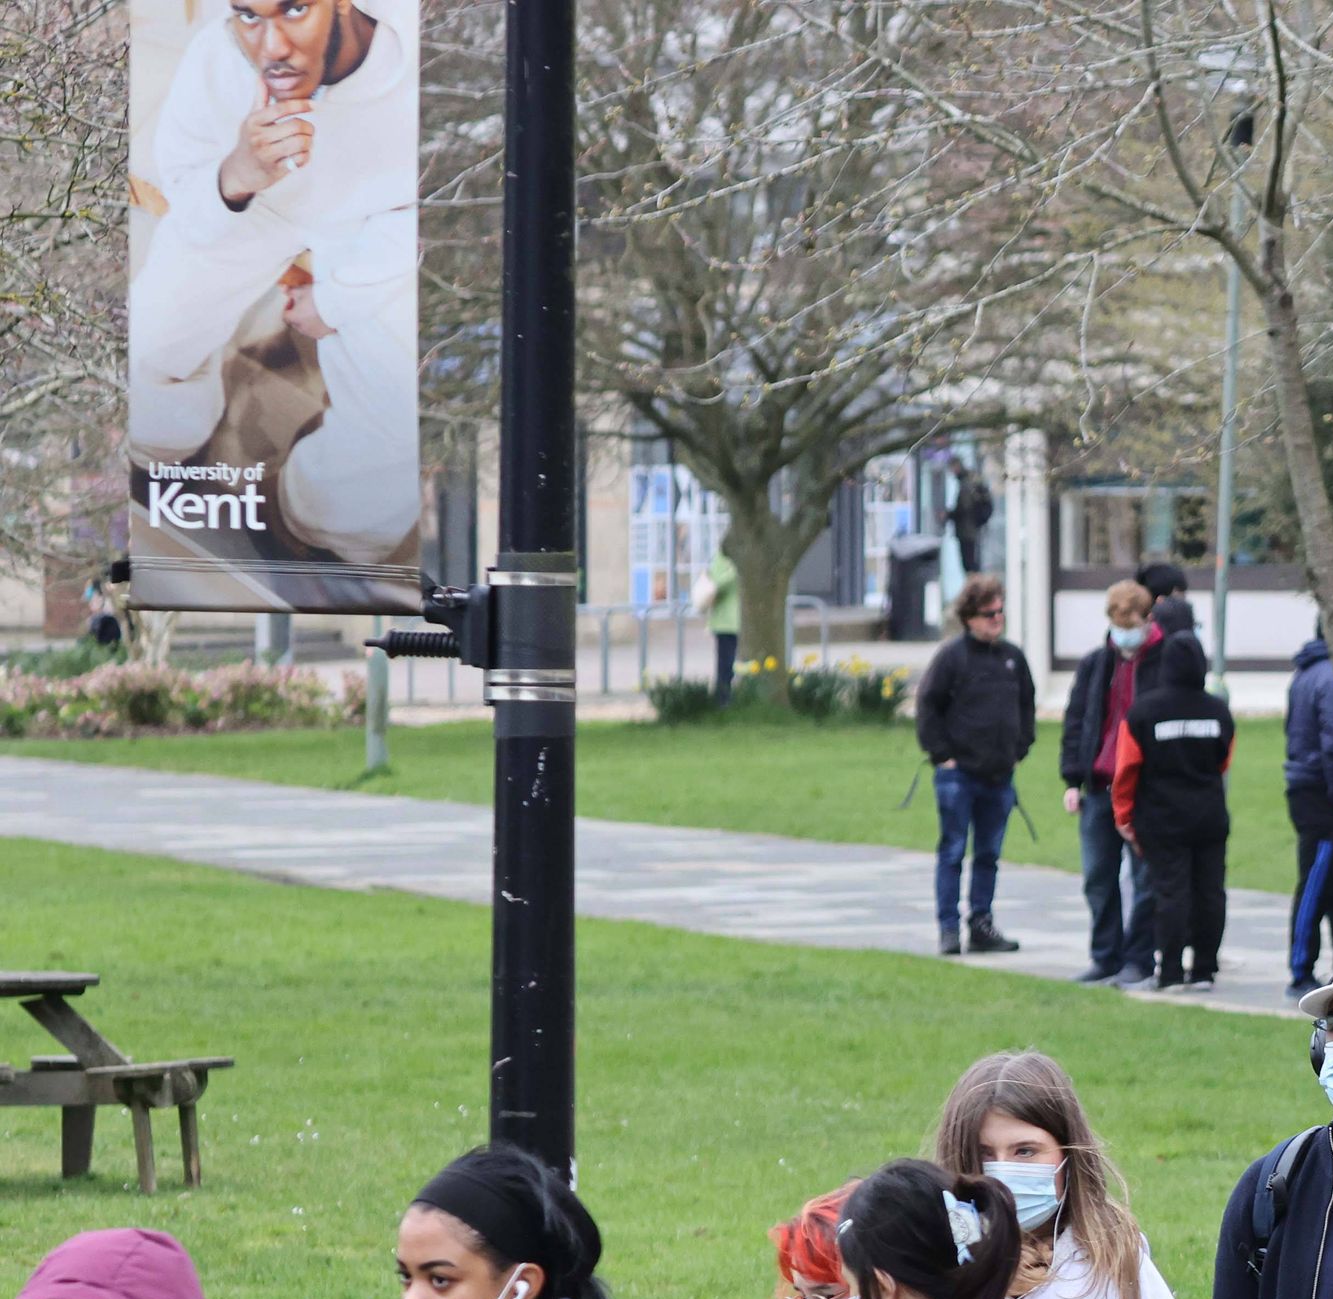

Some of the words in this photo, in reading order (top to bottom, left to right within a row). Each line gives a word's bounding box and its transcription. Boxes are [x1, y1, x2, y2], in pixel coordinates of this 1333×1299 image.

[149, 462, 240, 487] University
[243, 462, 266, 481] of
[149, 481, 267, 531] Kent
